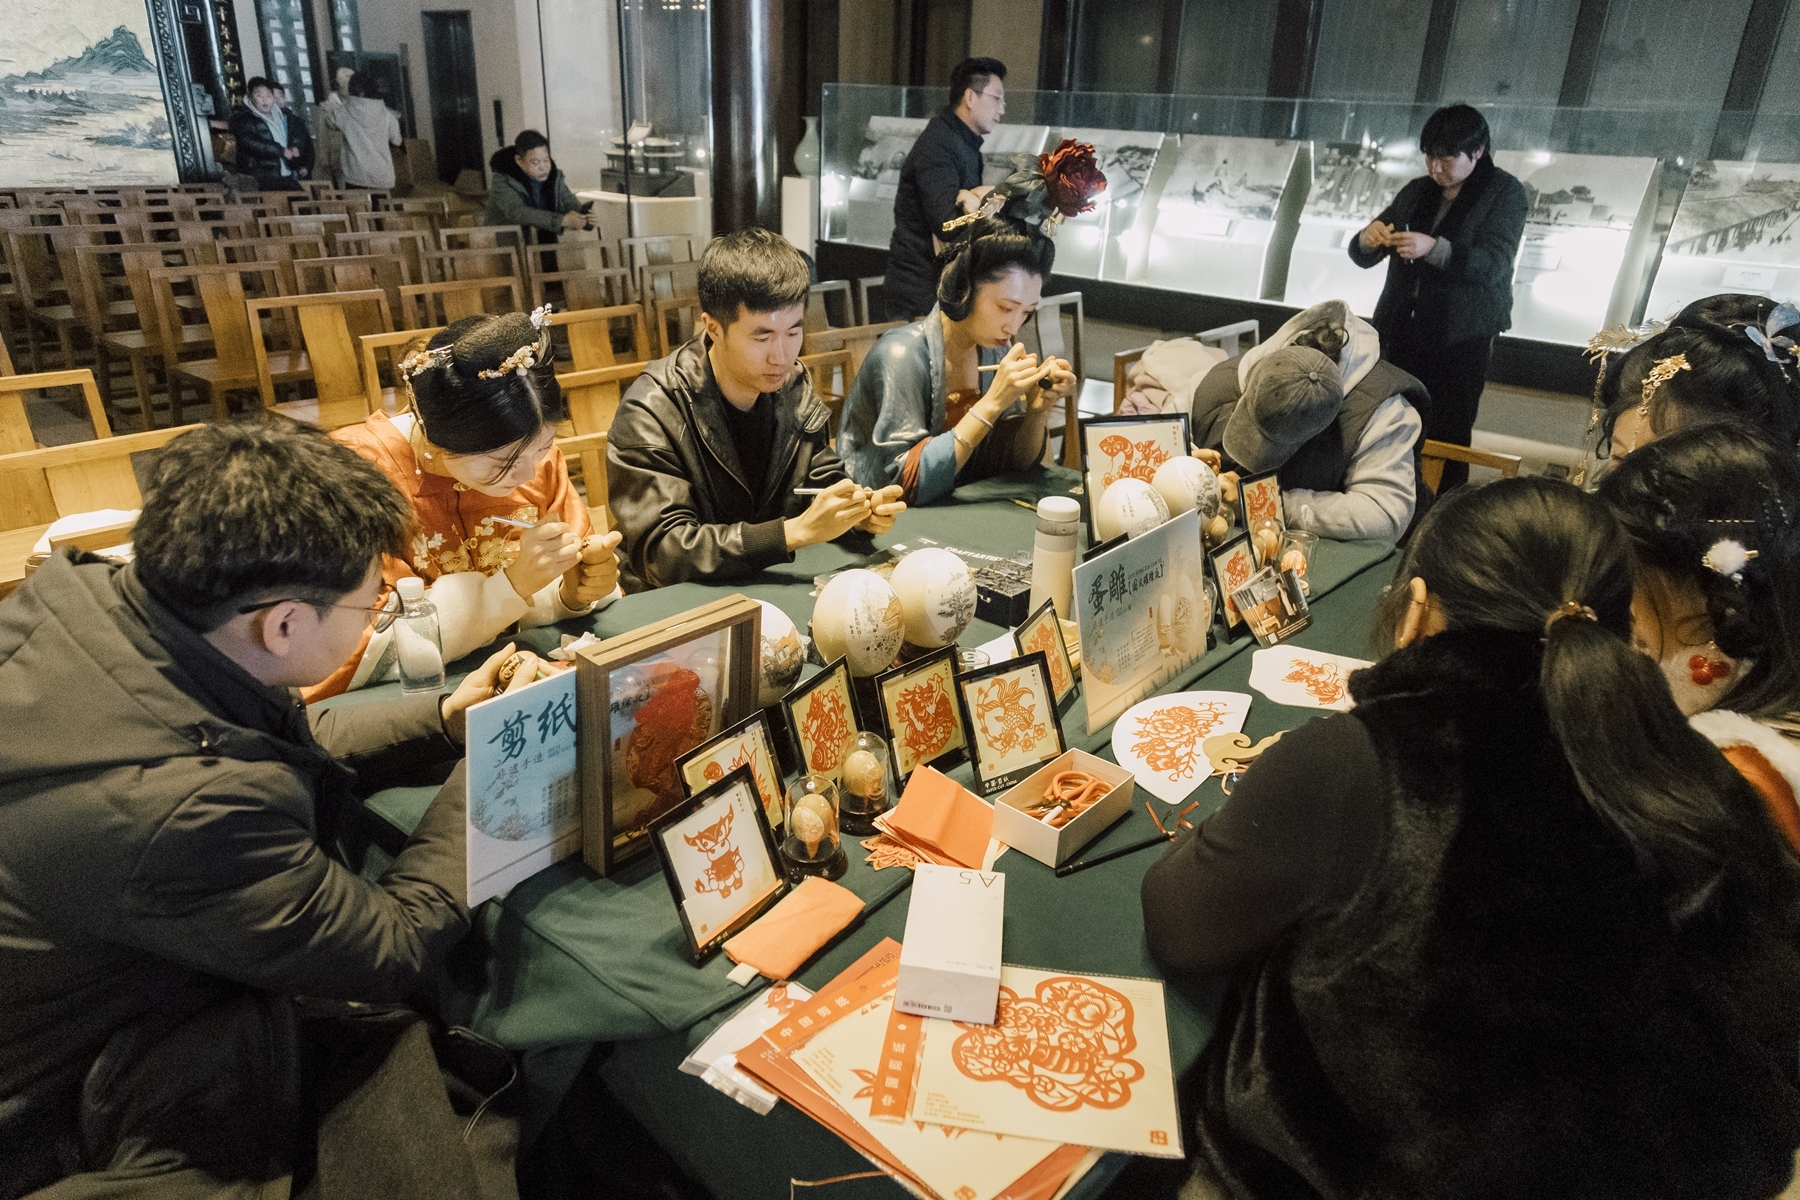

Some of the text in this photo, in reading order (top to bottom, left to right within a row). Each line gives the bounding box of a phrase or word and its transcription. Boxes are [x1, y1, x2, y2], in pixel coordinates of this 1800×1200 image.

[1088, 564, 1128, 616] 蛋雕
[487, 692, 576, 764] 剪纸
[959, 870, 997, 888] A5
